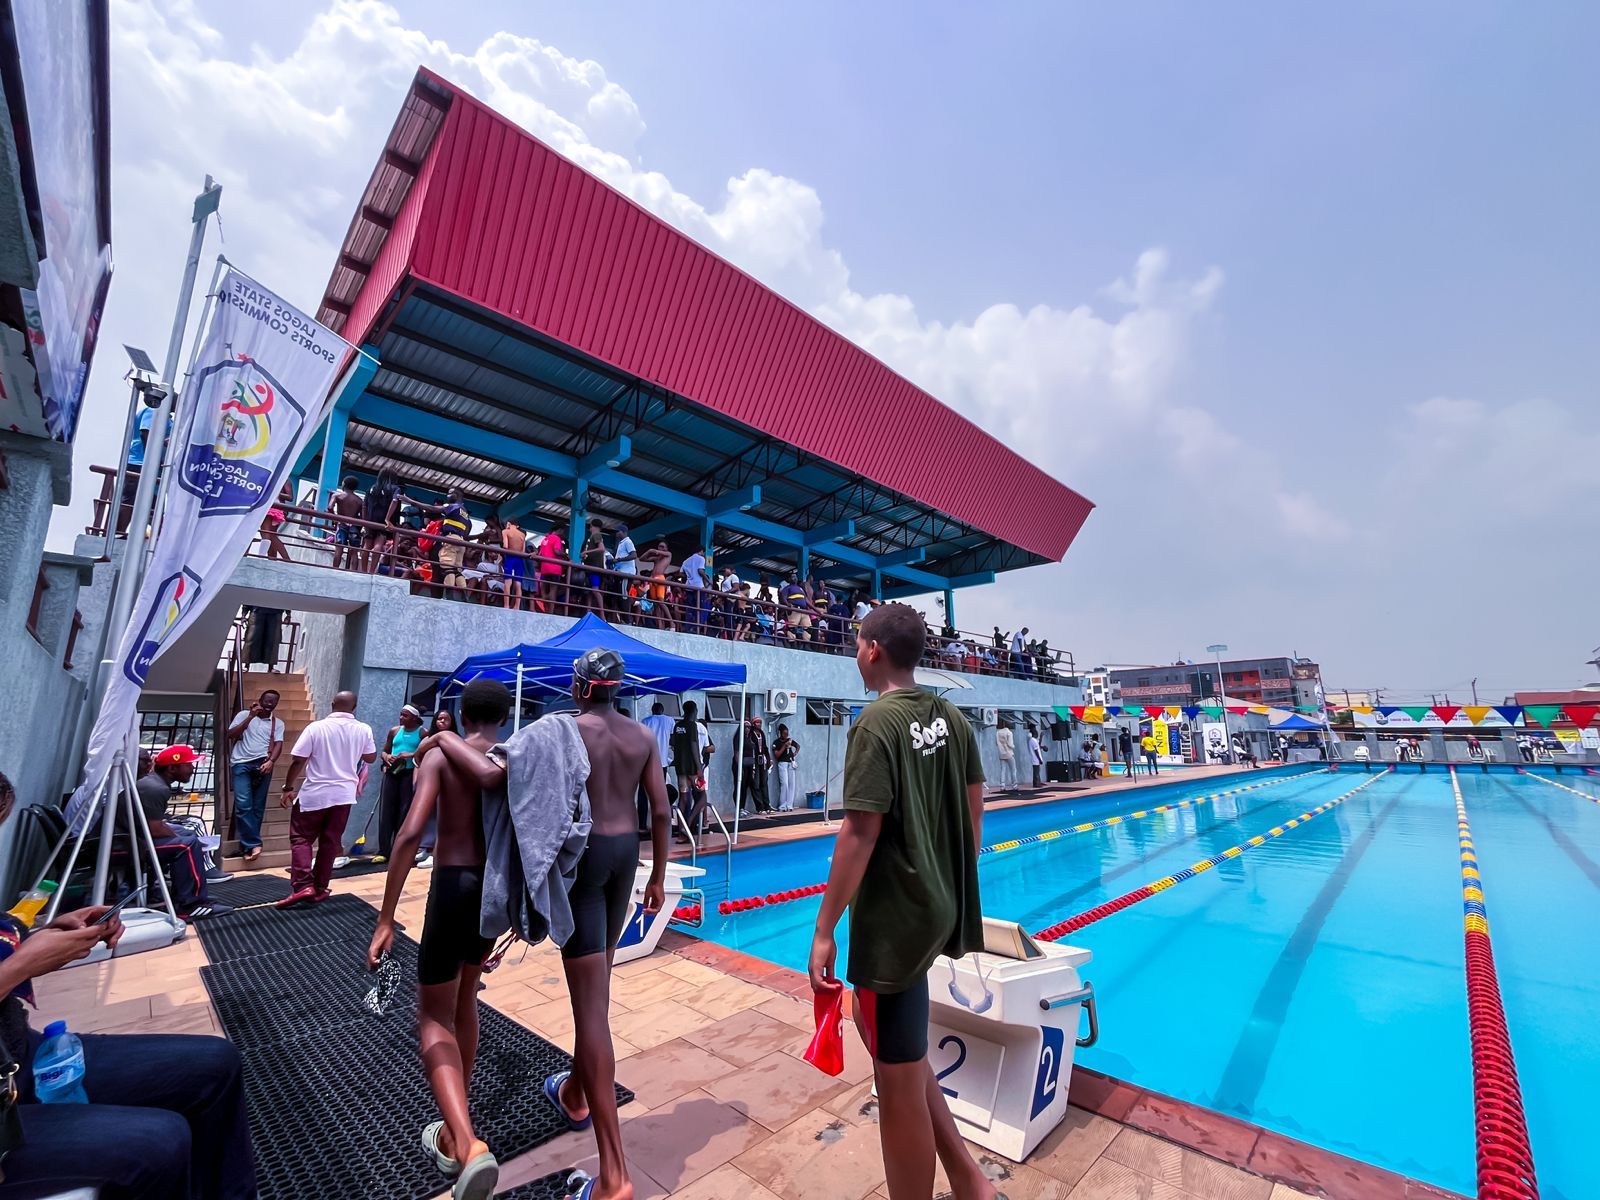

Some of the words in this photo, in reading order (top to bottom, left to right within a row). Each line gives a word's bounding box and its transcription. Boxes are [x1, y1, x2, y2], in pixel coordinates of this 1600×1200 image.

[635, 913, 644, 938] 1
[936, 1035, 967, 1099] 2
[1041, 1045, 1056, 1096] 2
